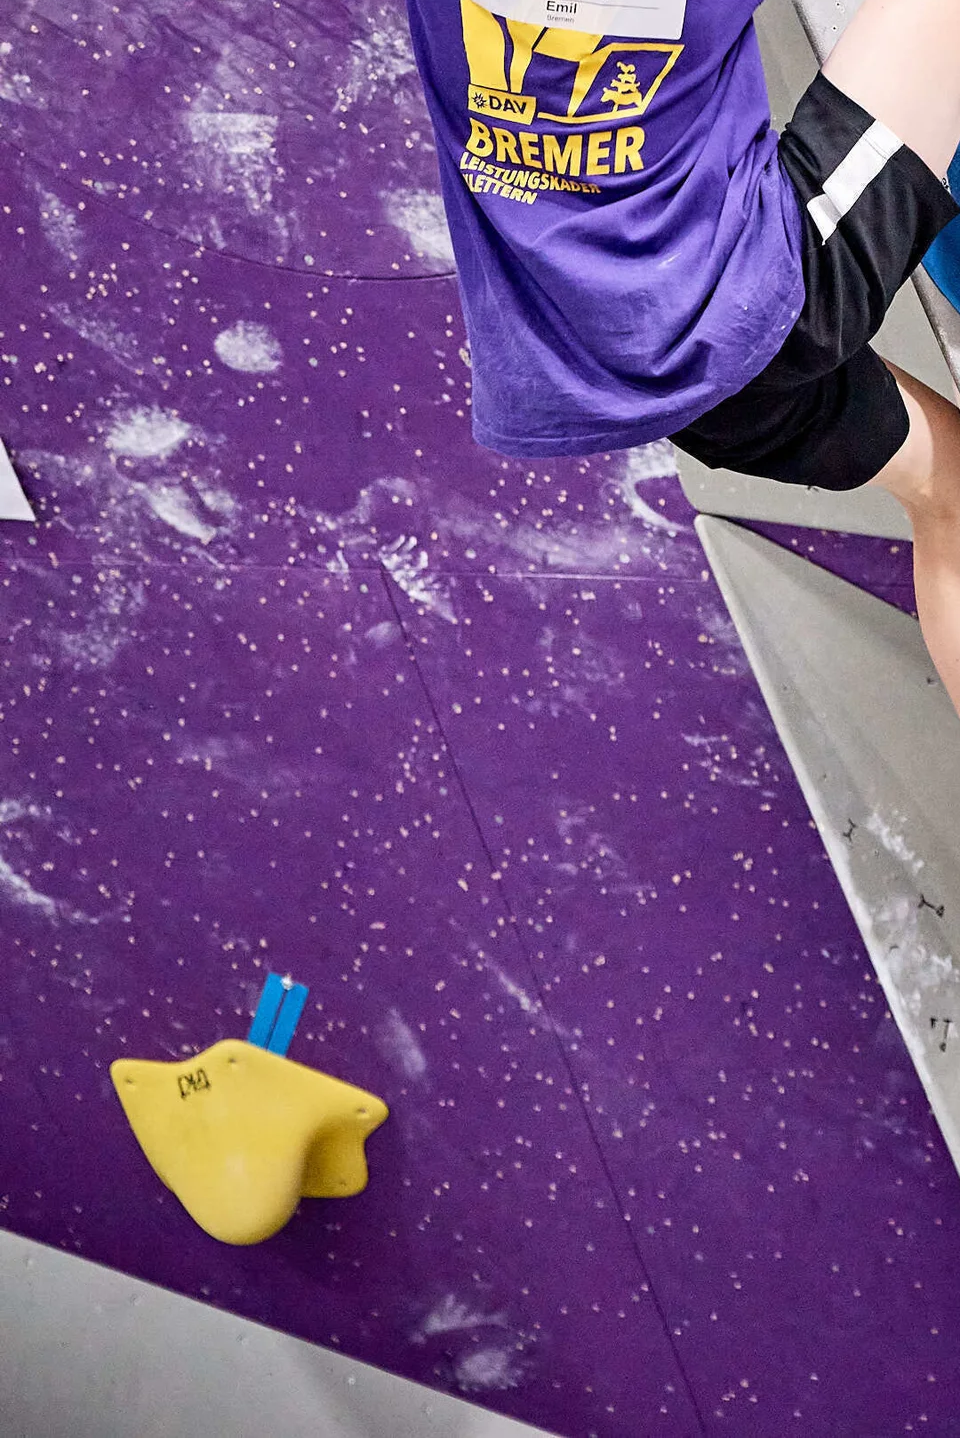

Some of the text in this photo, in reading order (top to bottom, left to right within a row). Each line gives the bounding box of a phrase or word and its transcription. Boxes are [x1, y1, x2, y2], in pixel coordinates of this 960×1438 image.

[546, 0, 578, 15] Emil
[489, 95, 527, 115] DAV
[465, 117, 645, 177] BREMER
